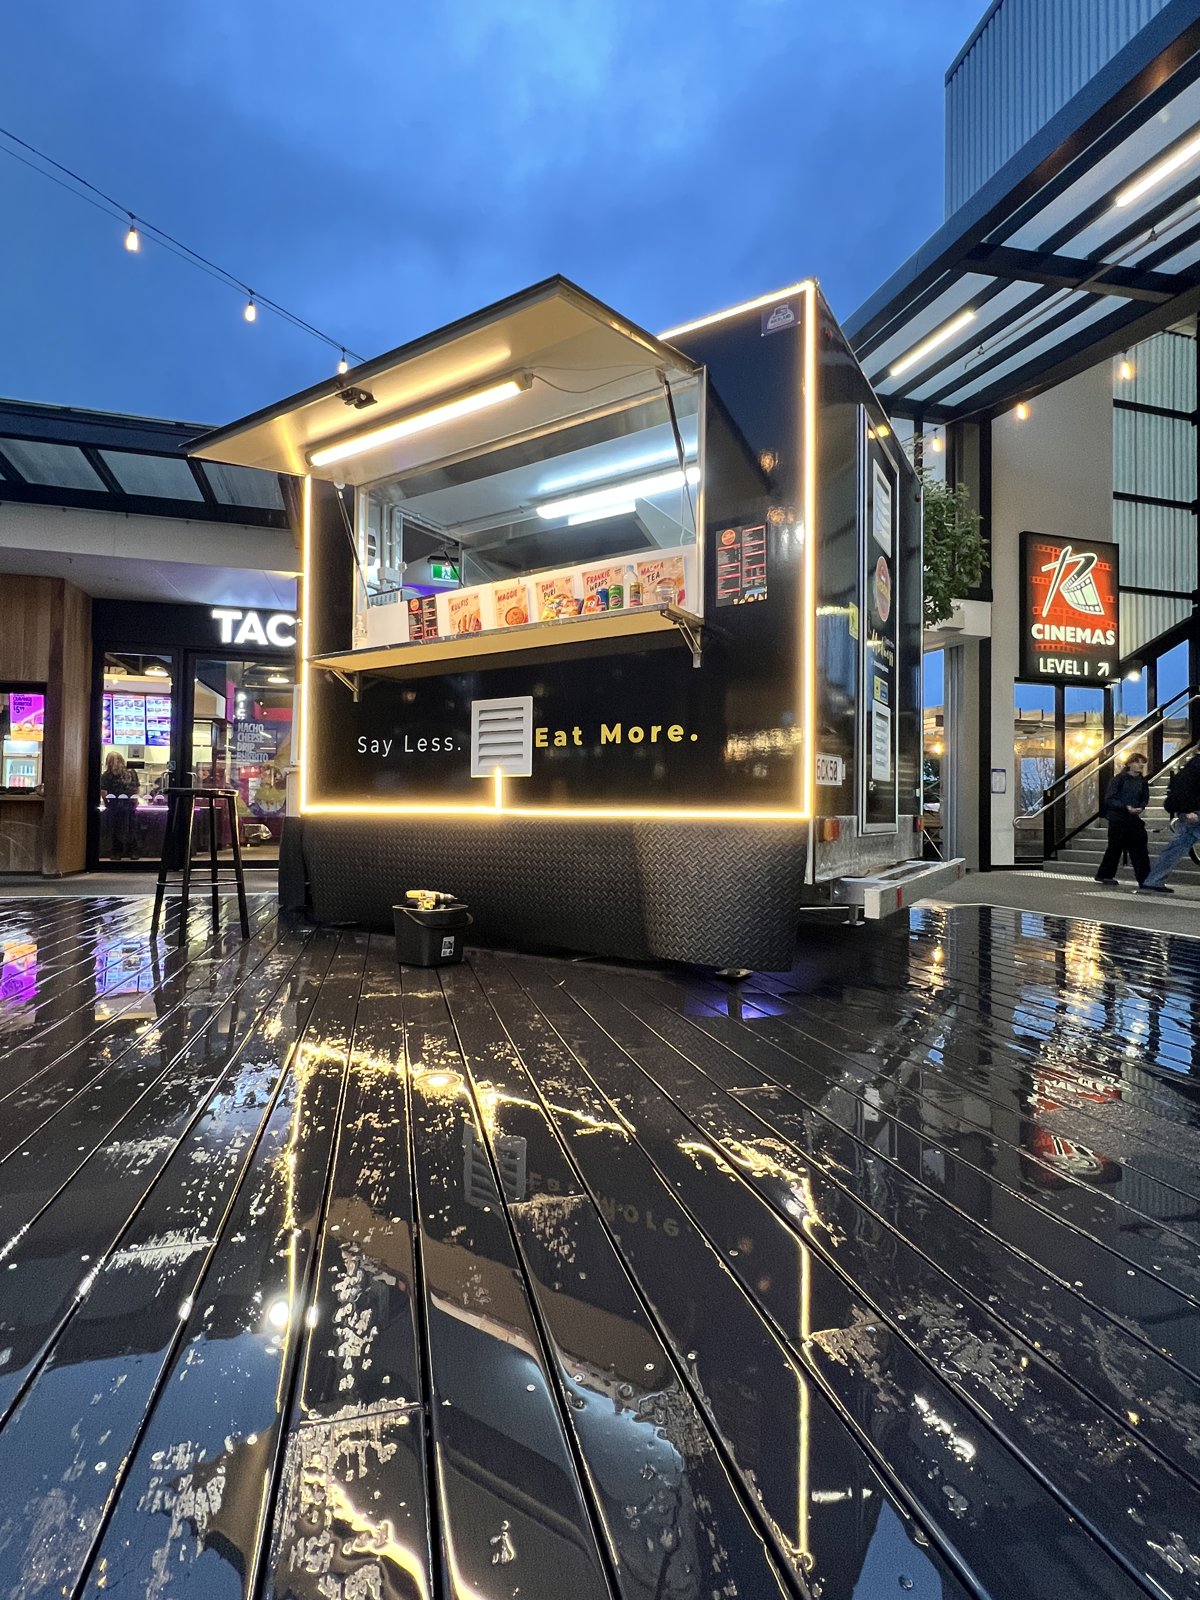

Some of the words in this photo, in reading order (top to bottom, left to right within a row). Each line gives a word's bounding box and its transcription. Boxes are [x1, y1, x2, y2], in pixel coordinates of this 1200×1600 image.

[586, 569, 611, 586] FRANKIE
[646, 571, 661, 583] TEA
[590, 579, 608, 591] WRAPS
[497, 589, 518, 602] MAGGIE
[1031, 623, 1116, 646] CINEMAS
[1039, 657, 1081, 675] LEVEL
[237, 722, 264, 733] NACHO
[237, 732, 265, 743] CHEESE
[535, 725, 583, 748] Eat
[600, 722, 698, 745] More.
[237, 742, 256, 752] DRIP
[357, 735, 393, 758] Say
[404, 734, 462, 753] Less.
